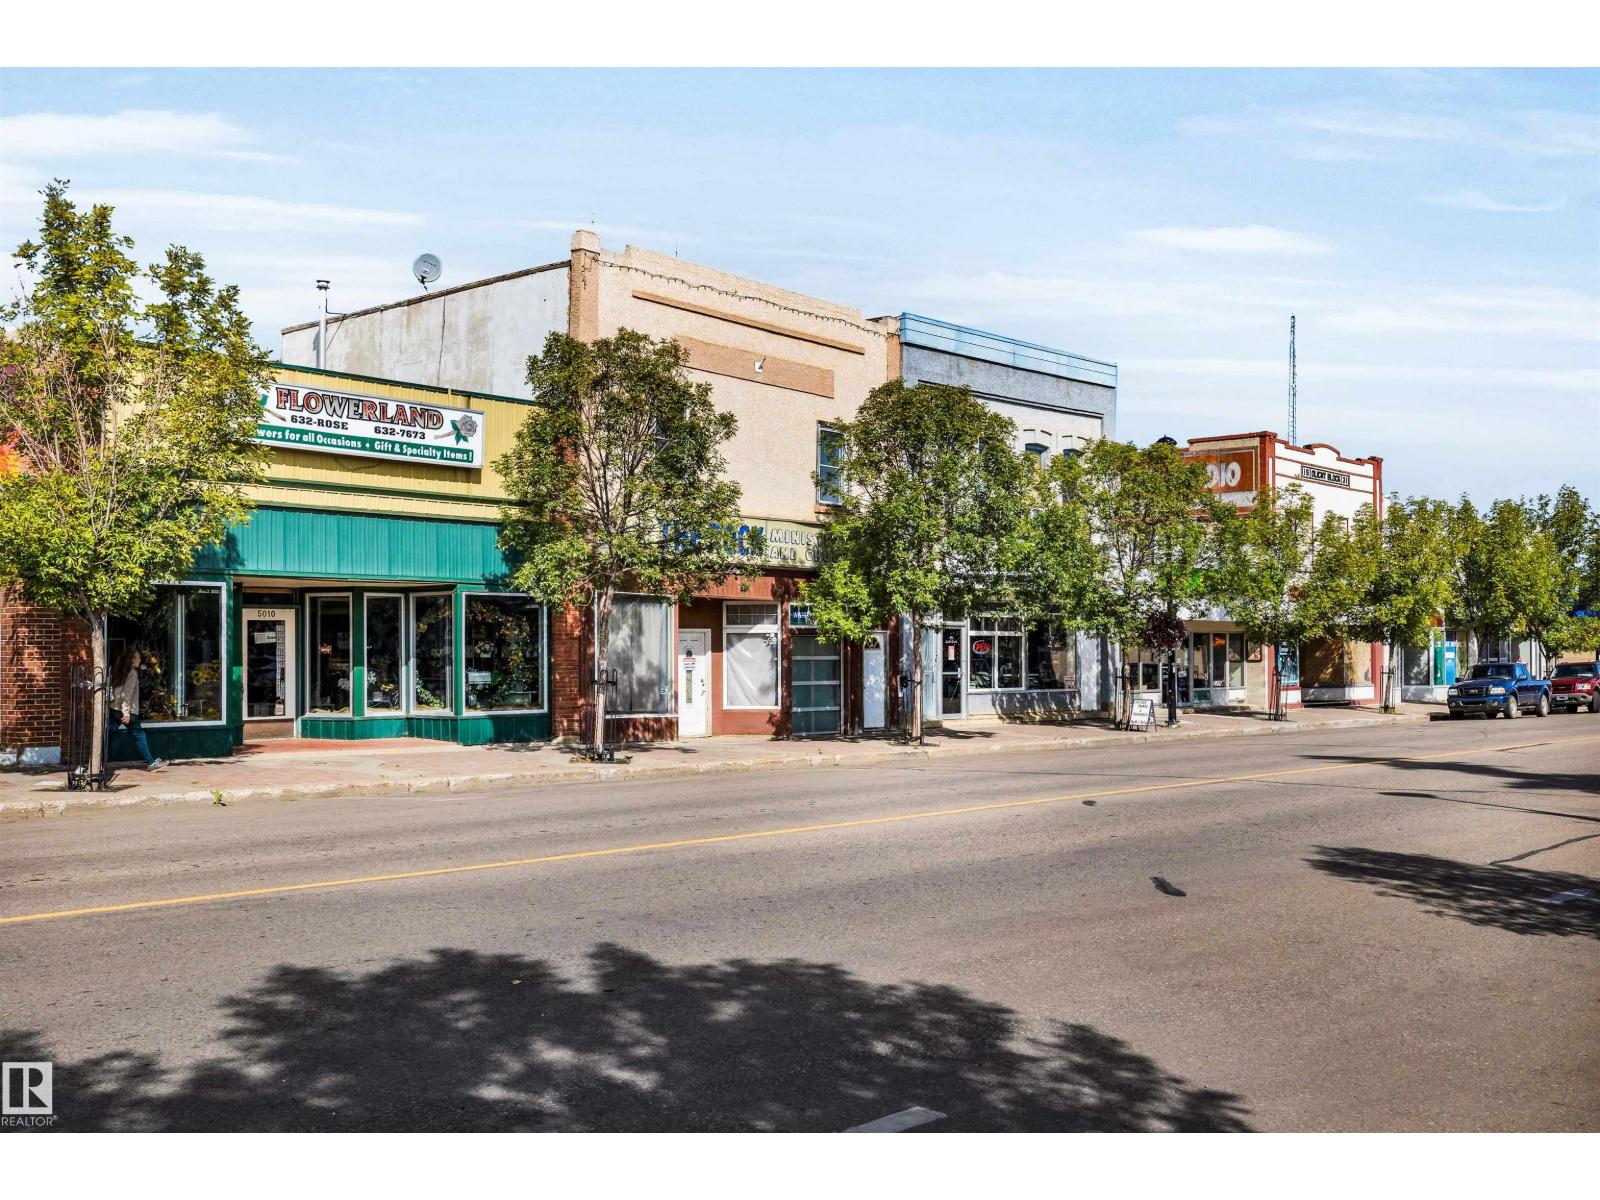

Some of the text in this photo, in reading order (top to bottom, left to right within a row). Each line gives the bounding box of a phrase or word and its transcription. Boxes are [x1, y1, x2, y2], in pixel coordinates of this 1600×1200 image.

[276, 387, 443, 430] FLOWERLAND
[290, 415, 349, 430] 632-ROSE
[374, 426, 426, 440] 632-7673
[256, 428, 283, 439] wers
[285, 429, 300, 440] for
[302, 433, 315, 443] all
[316, 434, 362, 448] Occasions
[374, 440, 392, 451] Gift
[393, 443, 401, 453] &
[402, 444, 442, 459] Specialty
[769, 546, 797, 561] AND
[257, 610, 275, 618] 5010
